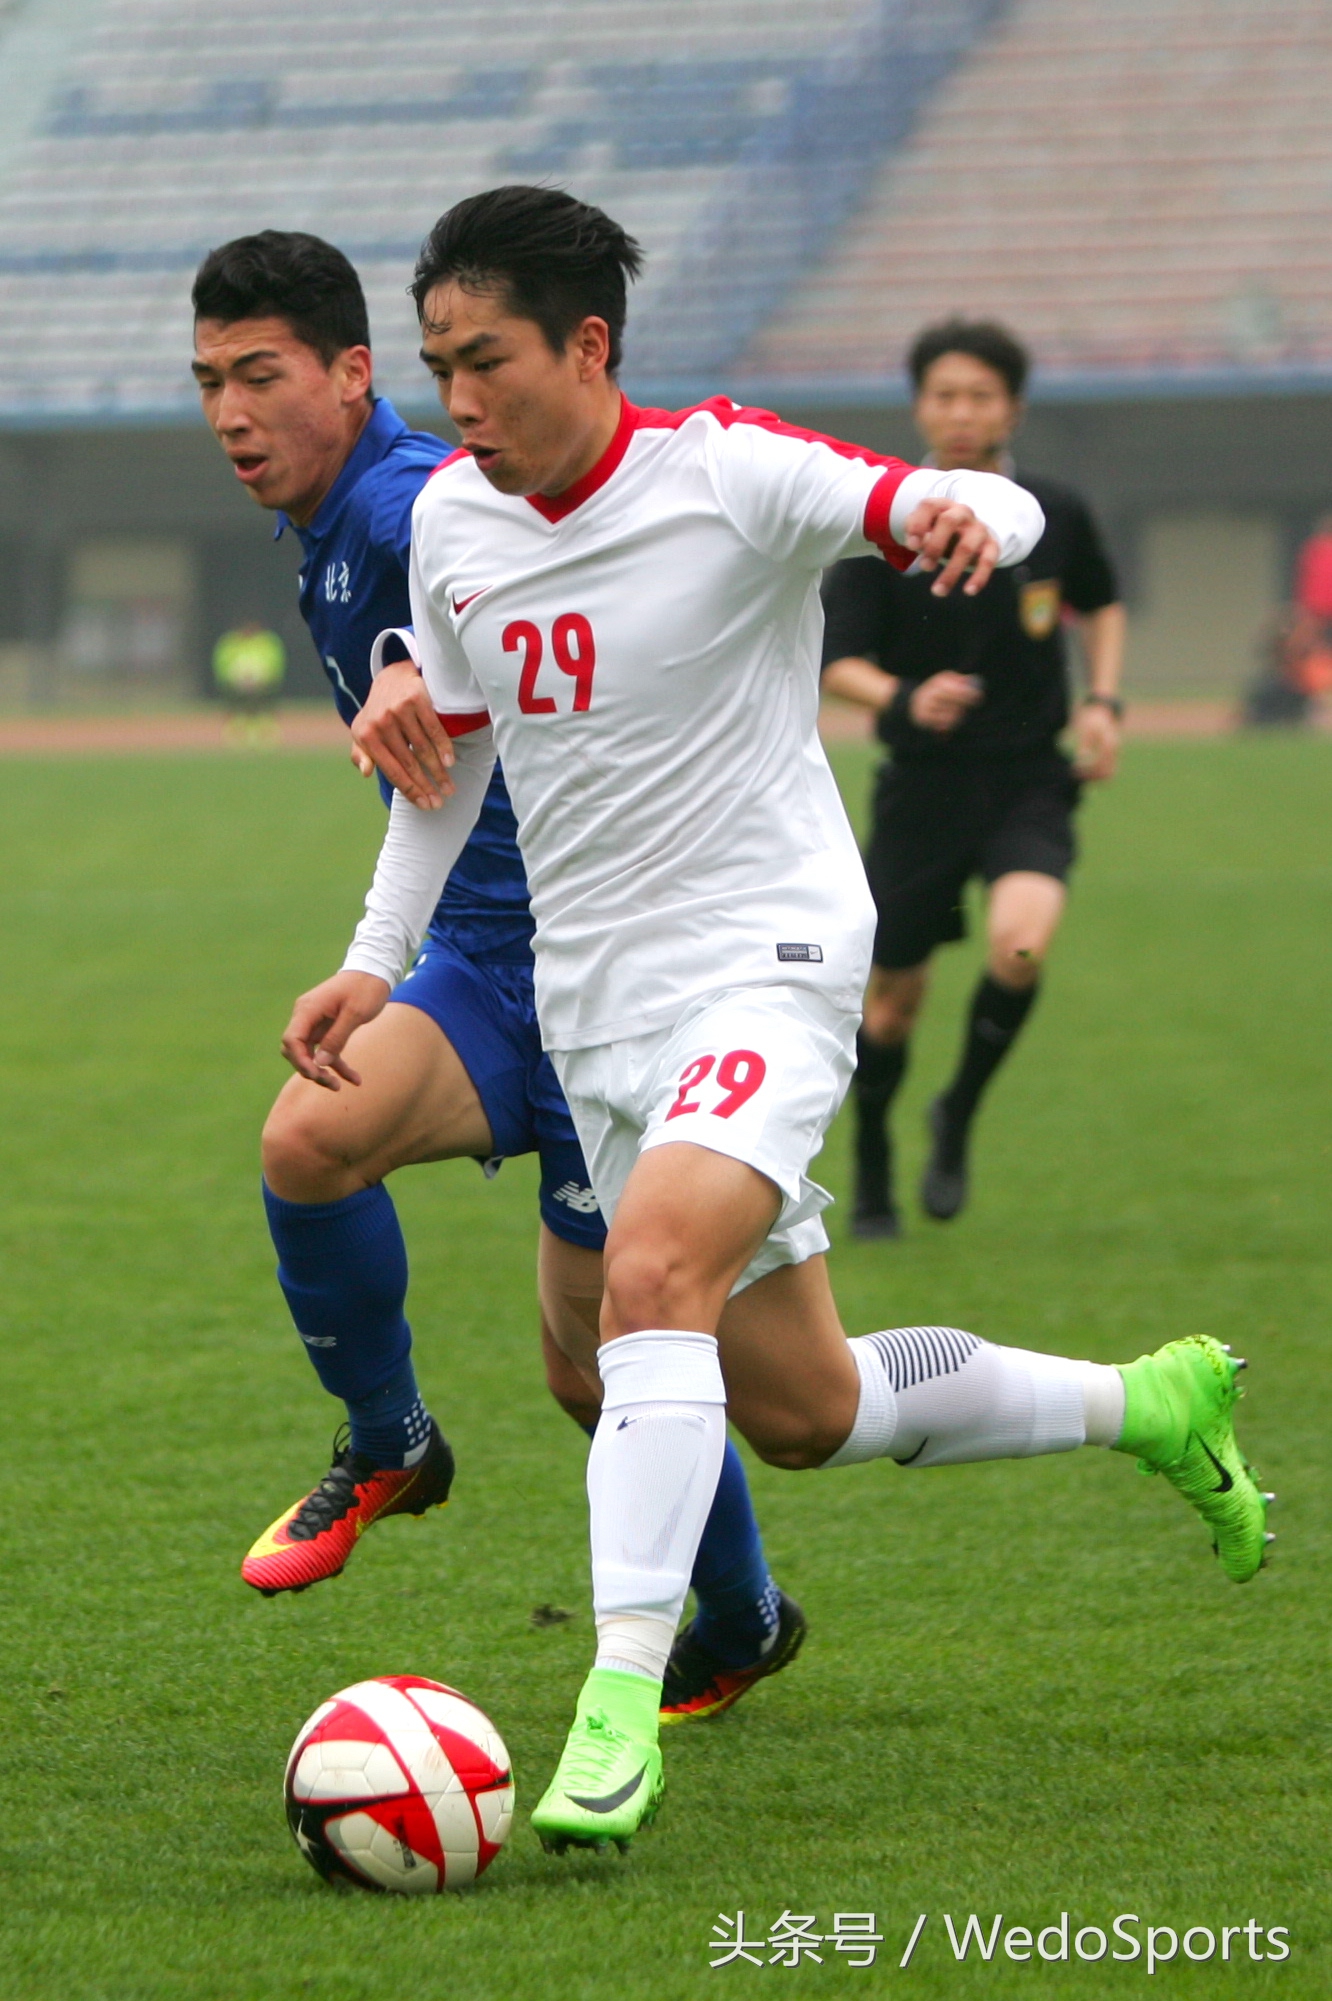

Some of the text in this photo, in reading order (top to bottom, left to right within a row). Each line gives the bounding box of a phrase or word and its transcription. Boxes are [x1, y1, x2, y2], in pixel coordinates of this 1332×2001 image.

[325, 561, 351, 602] 北京
[502, 612, 596, 714] 29
[664, 1049, 766, 1122] 29
